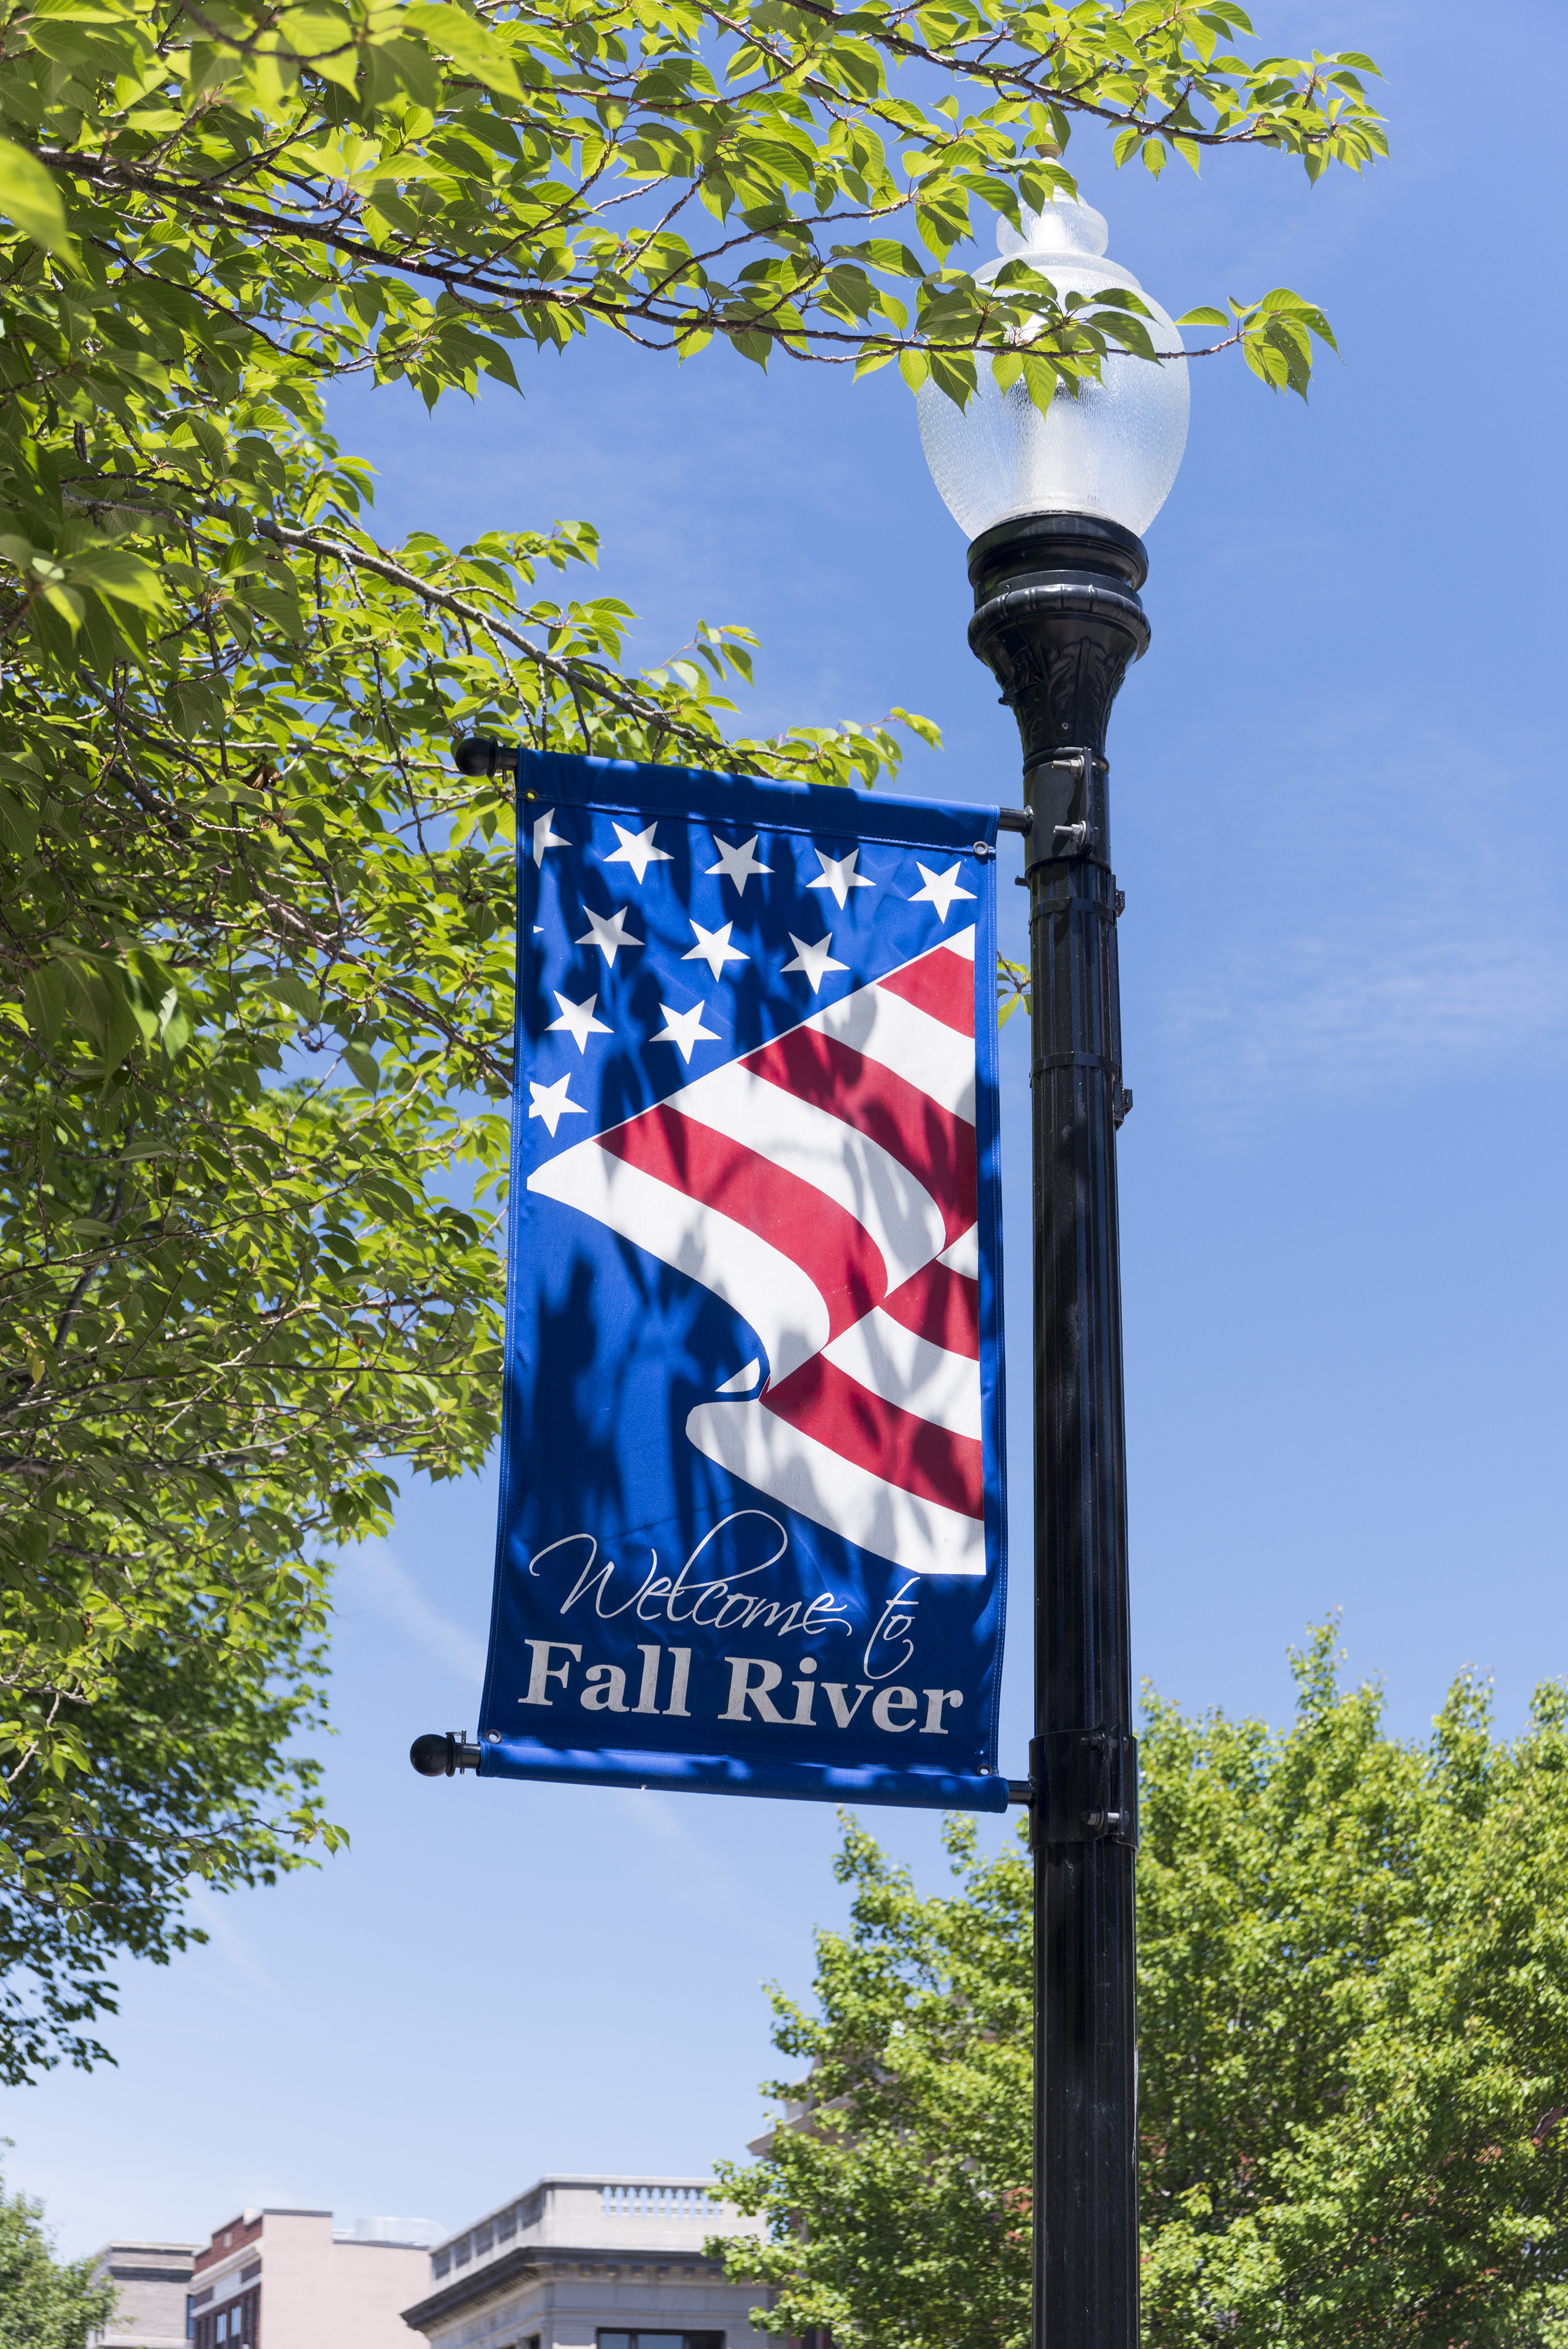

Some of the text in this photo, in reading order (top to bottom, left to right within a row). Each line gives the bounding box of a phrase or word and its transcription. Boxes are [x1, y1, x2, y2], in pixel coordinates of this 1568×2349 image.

[529, 1509, 921, 1680] Welcome to
[517, 1638, 964, 1734] Fall River
